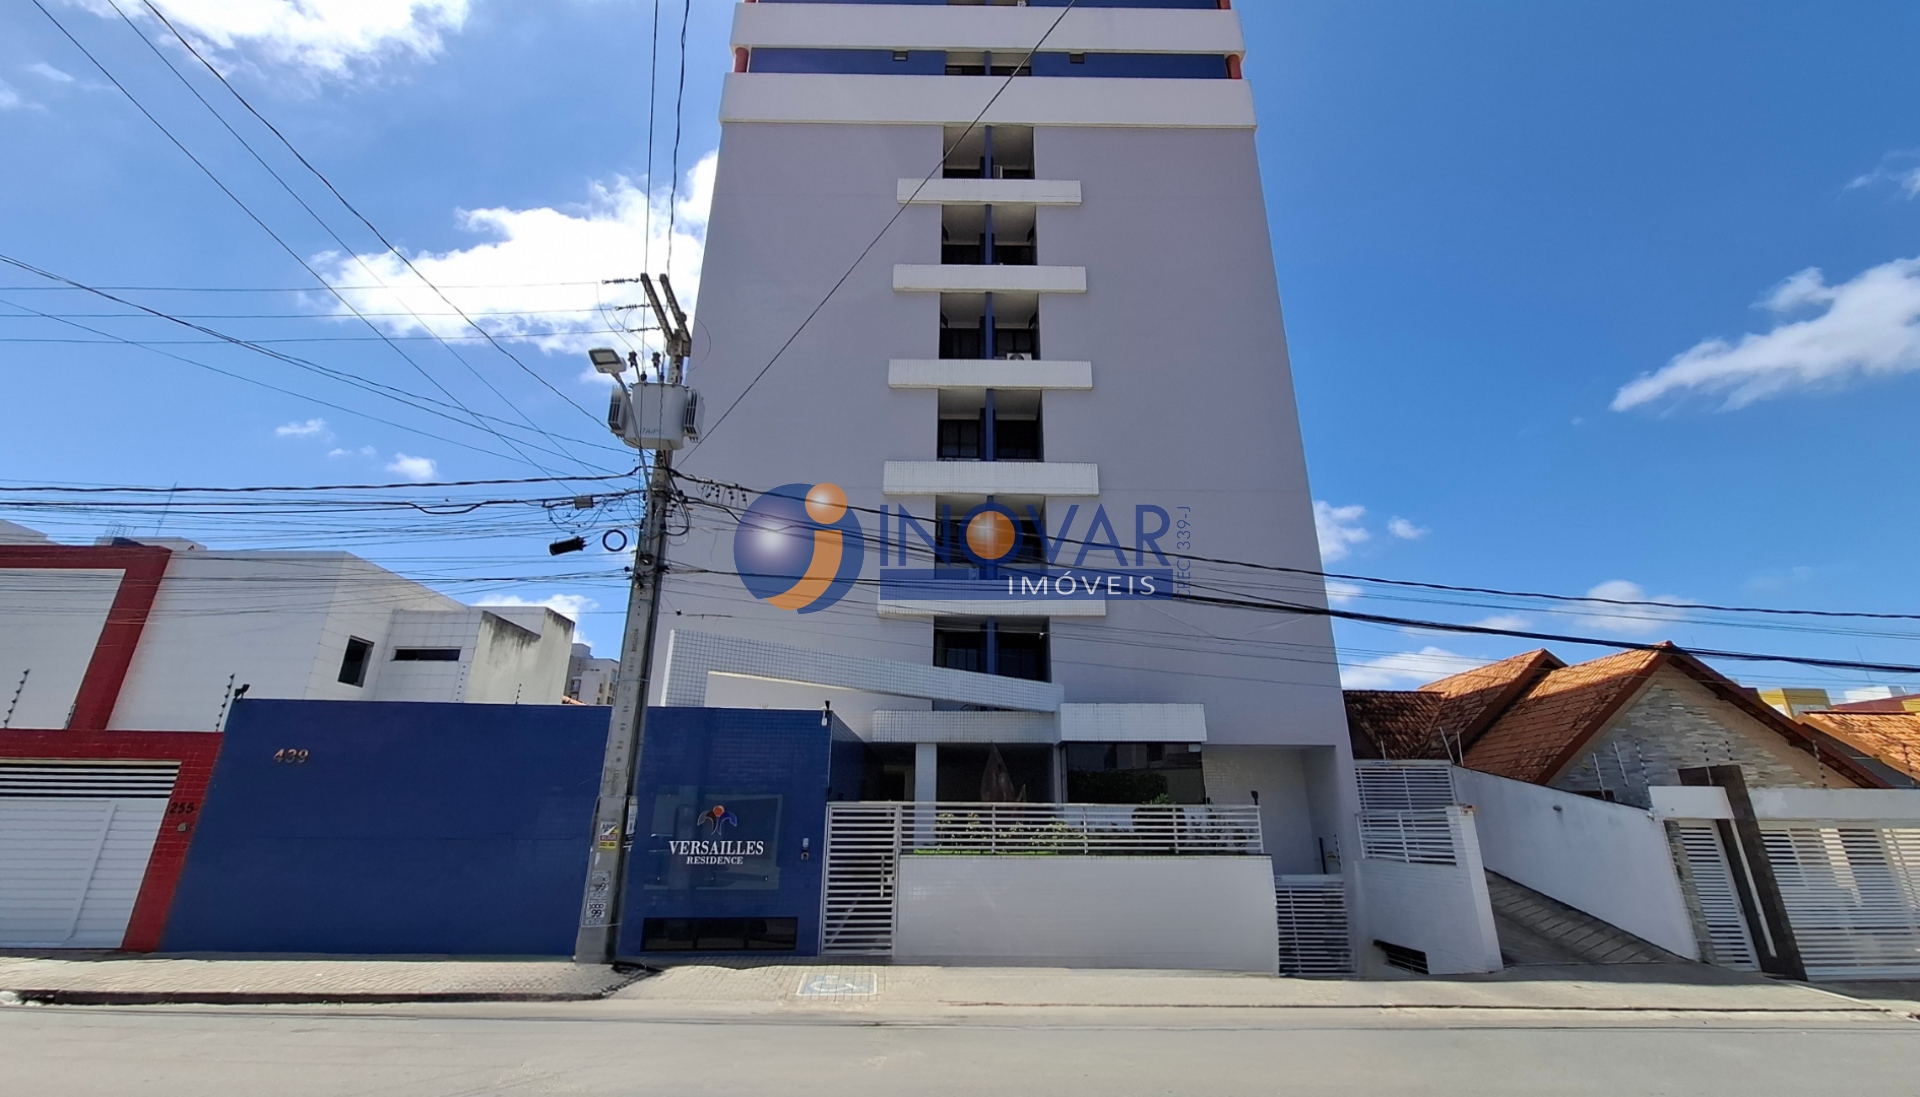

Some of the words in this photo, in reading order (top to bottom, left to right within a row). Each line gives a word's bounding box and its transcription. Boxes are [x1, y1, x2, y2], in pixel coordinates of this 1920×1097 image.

[273, 748, 309, 763] 439
[169, 802, 195, 814] 255
[669, 841, 764, 855] VERSAILLES
[686, 856, 743, 865] RESIDENCE
